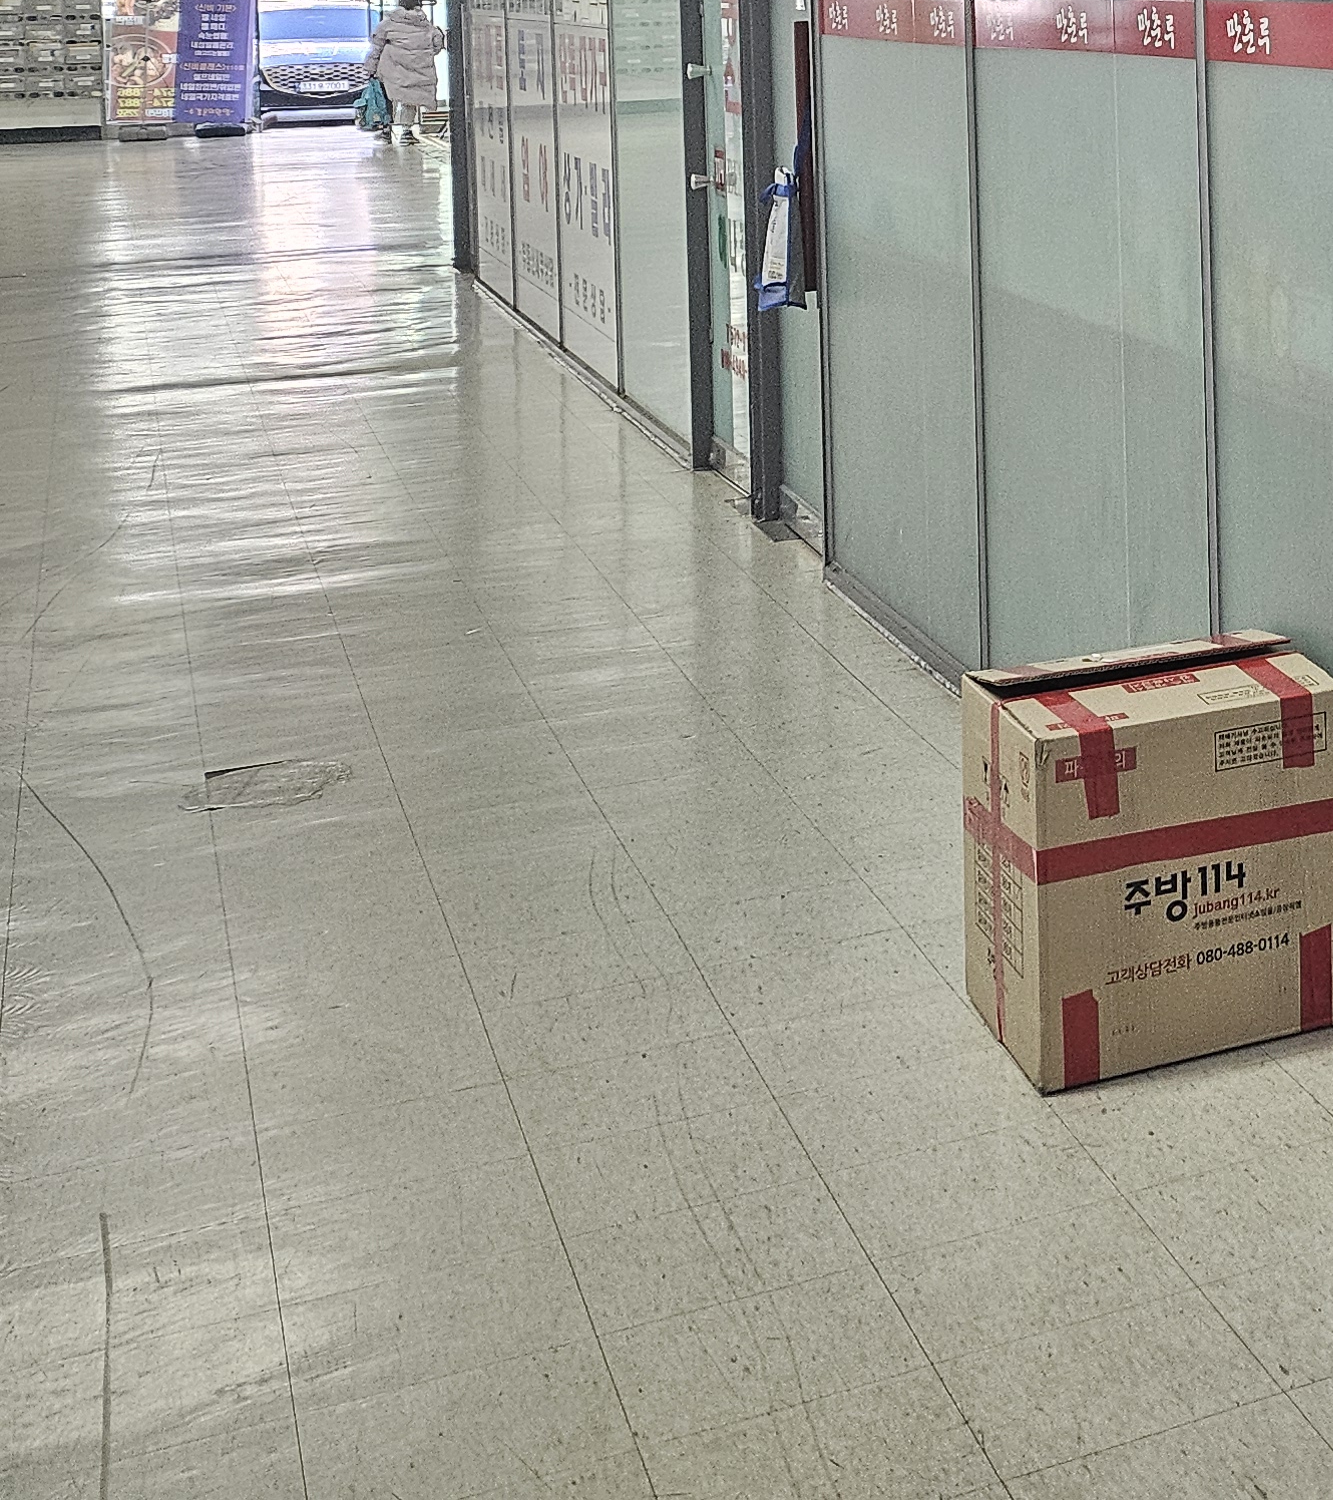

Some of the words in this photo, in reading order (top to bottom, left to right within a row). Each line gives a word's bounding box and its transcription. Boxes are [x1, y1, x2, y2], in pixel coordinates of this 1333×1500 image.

[1056, 5, 1089, 44] 만춘루
[1137, 7, 1176, 50] 만춘루
[1225, 9, 1271, 55] 만춘루
[1063, 749, 1127, 778] 파의
[1105, 951, 1191, 986] 고객상담전화
[1195, 933, 1290, 966] 080-488-0114
